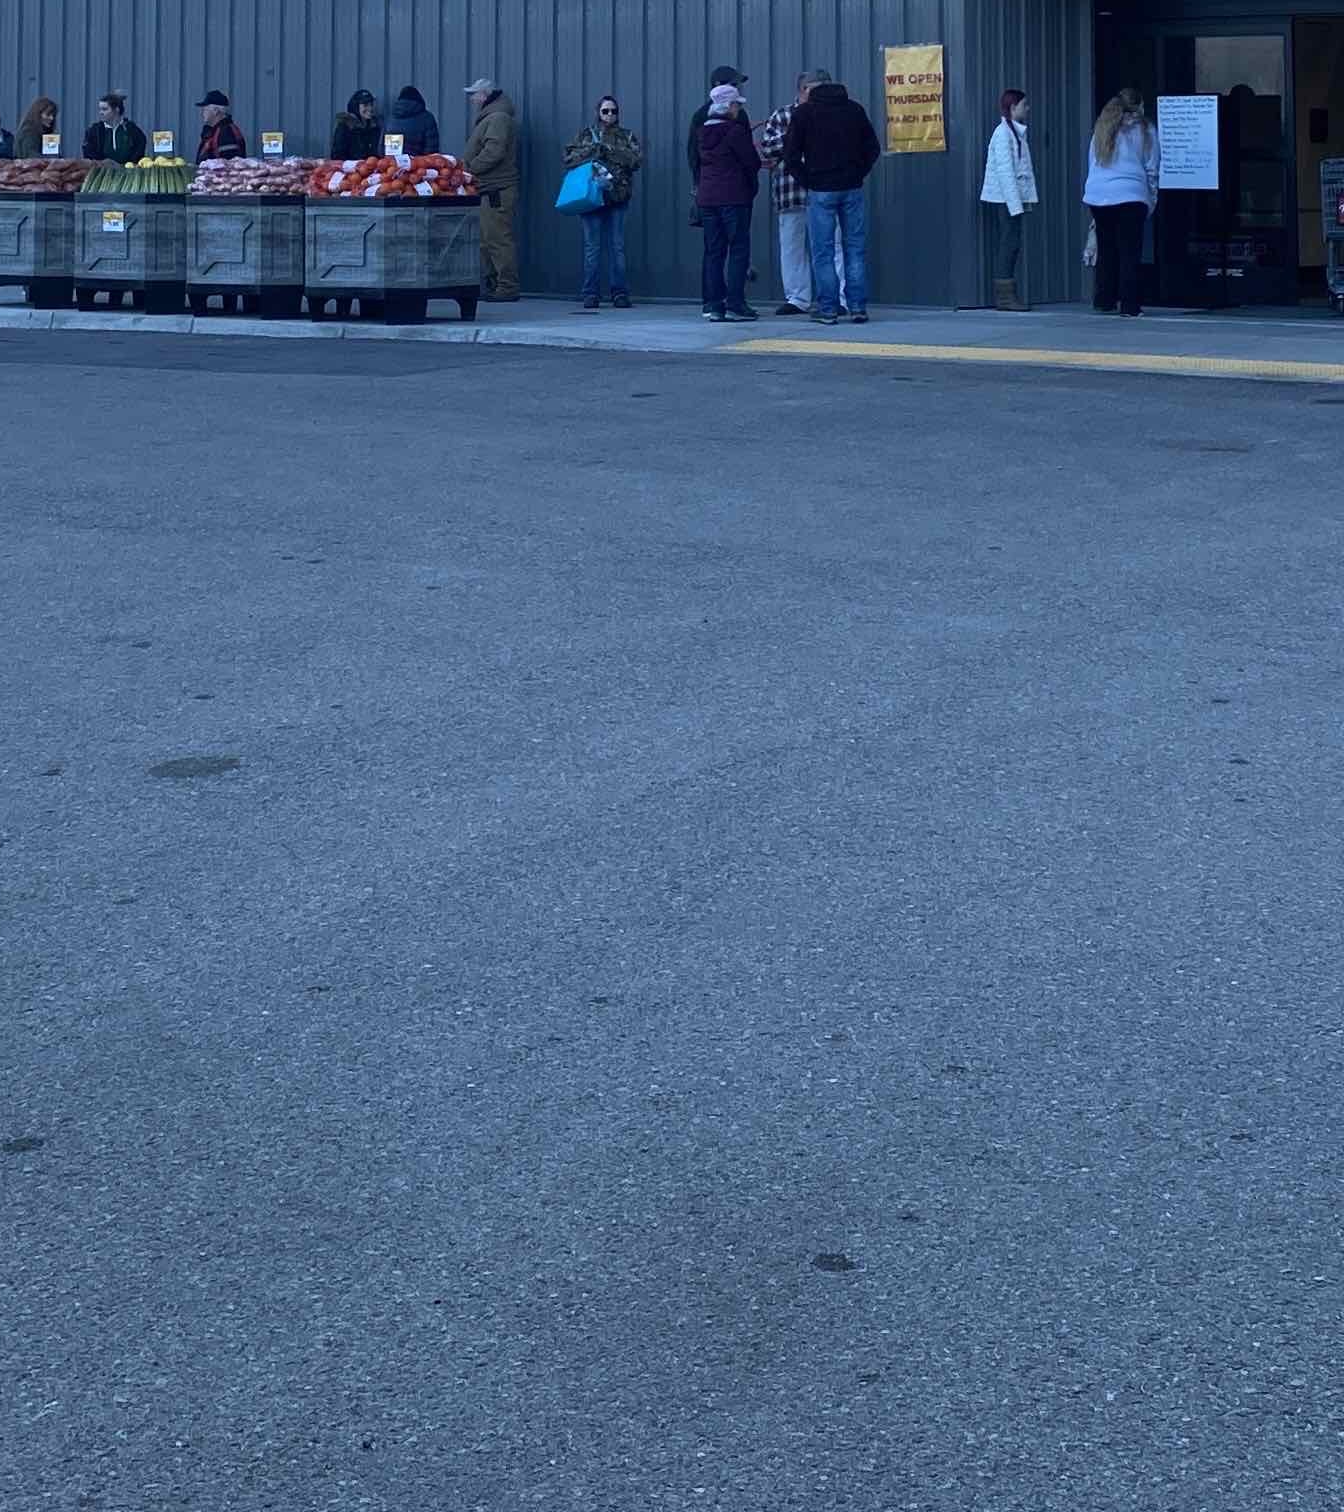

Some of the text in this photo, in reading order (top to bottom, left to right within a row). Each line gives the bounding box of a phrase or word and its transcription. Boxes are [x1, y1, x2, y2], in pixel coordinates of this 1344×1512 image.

[886, 72, 942, 86] WE OPEN
[887, 93, 943, 105] THURSDAY
